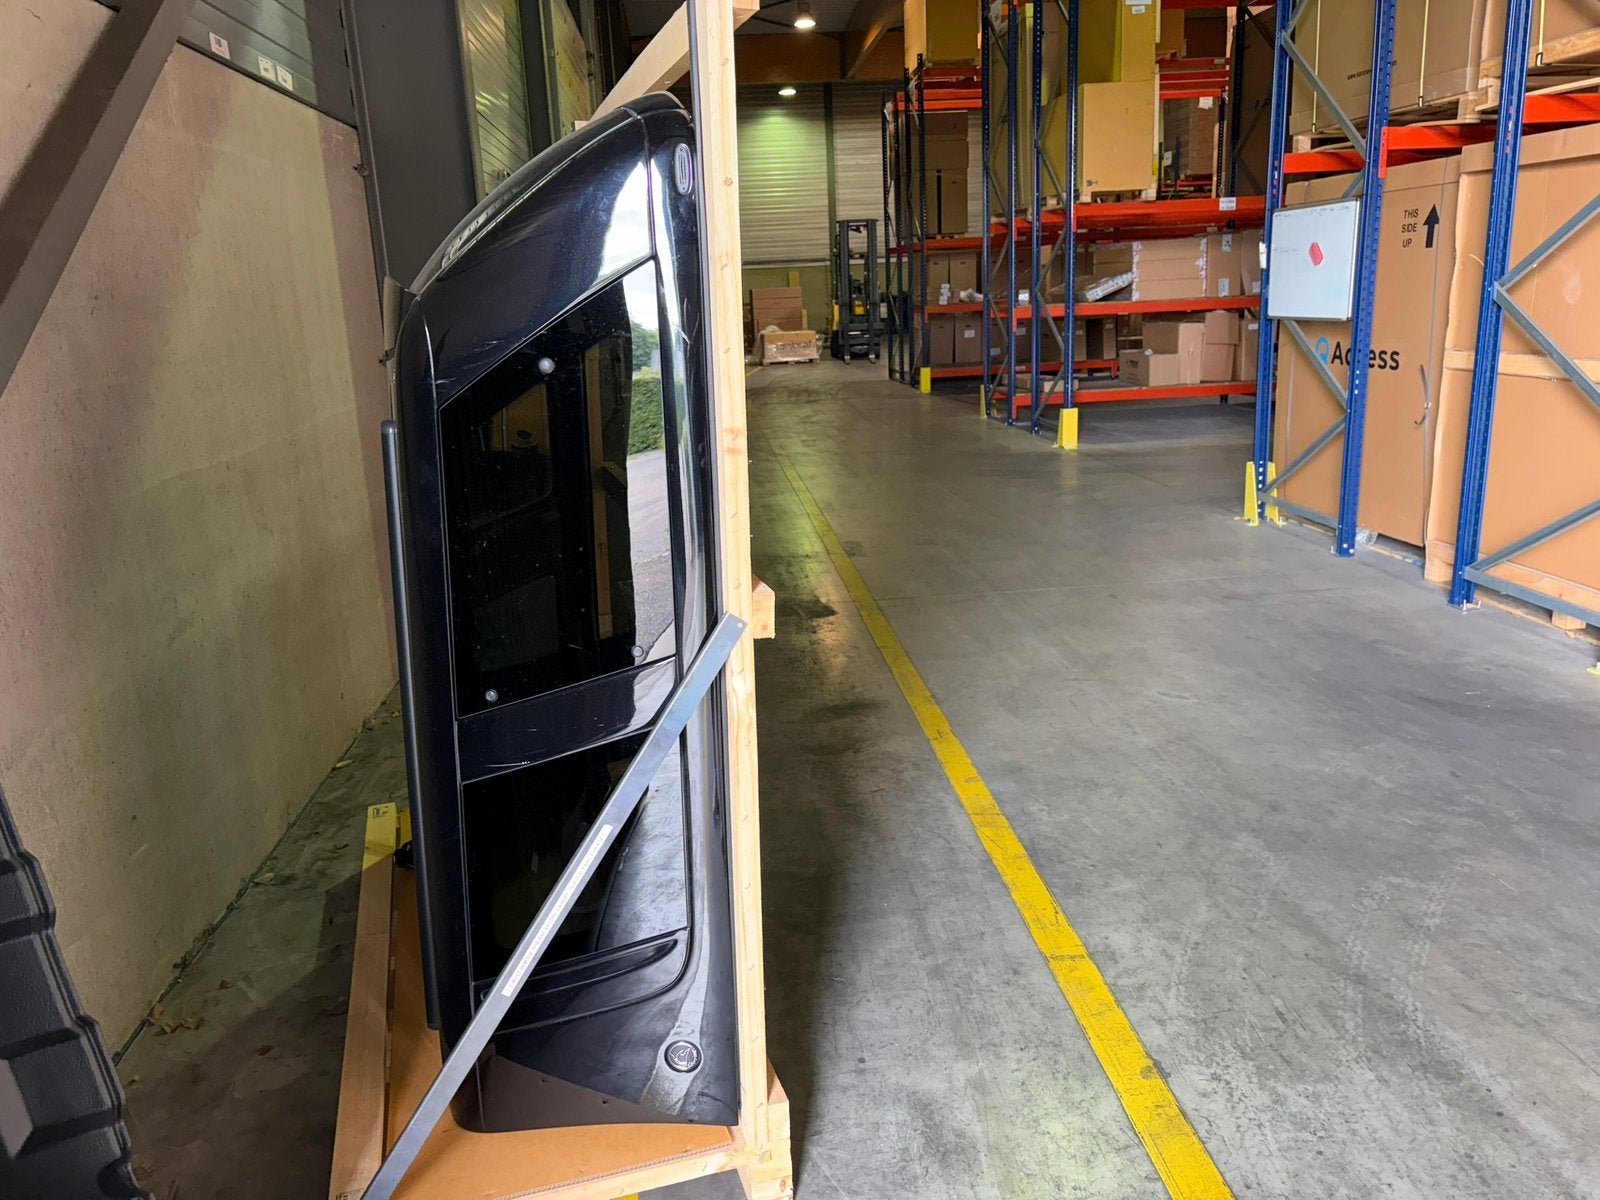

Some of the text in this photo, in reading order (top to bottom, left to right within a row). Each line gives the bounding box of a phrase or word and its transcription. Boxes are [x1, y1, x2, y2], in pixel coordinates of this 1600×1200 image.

[1403, 208, 1419, 219] THIS
[1401, 222, 1418, 233] SIDE
[1402, 237, 1413, 248] UP
[1330, 341, 1400, 370] Acess
